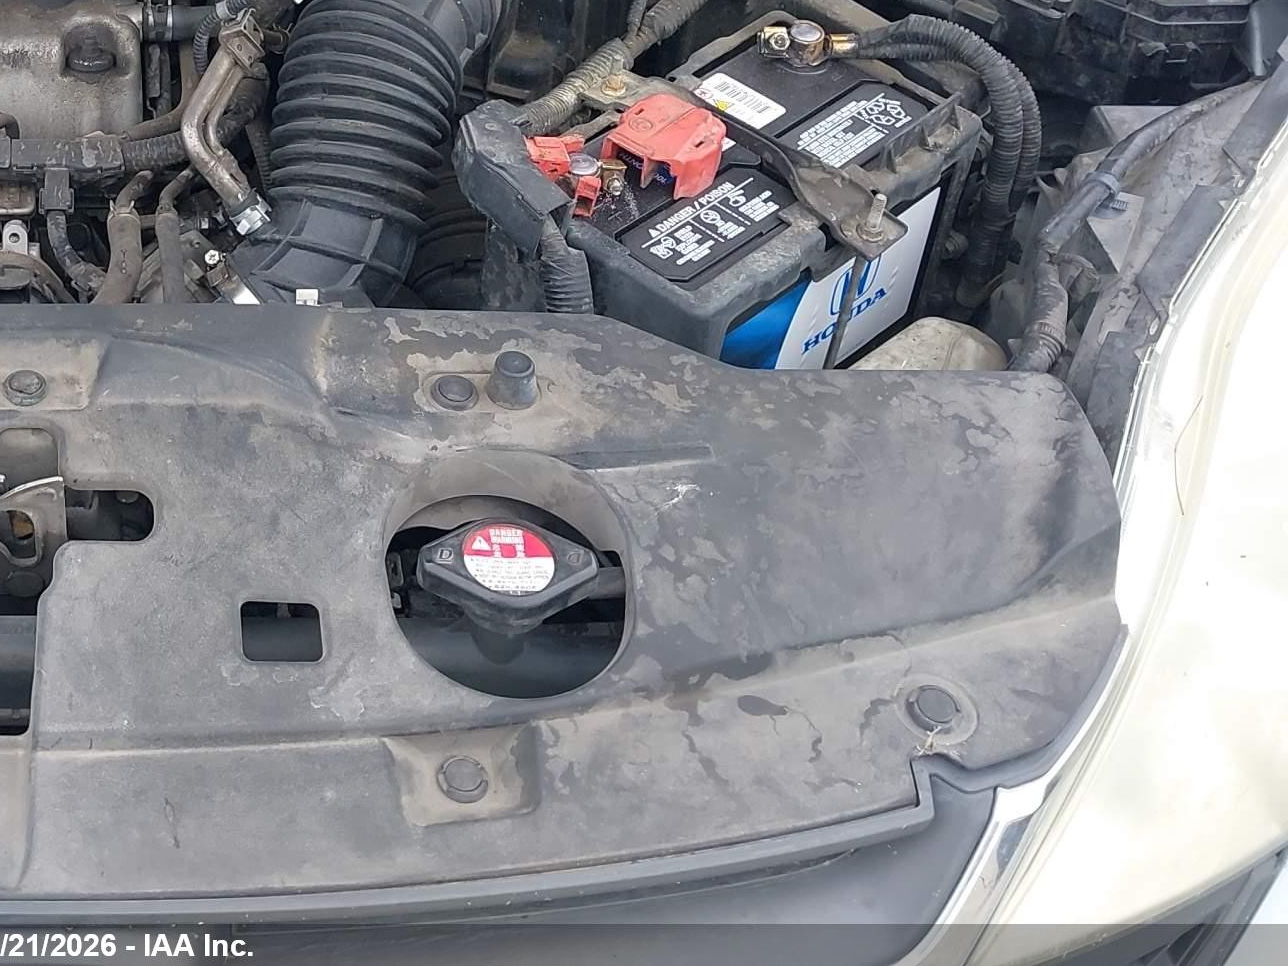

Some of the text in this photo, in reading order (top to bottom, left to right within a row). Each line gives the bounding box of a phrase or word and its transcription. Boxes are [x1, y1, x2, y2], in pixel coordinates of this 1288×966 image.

[655, 206, 697, 232] DANGER
[693, 200, 701, 210] /
[698, 182, 736, 205] POISON
[800, 287, 888, 355] HODA
